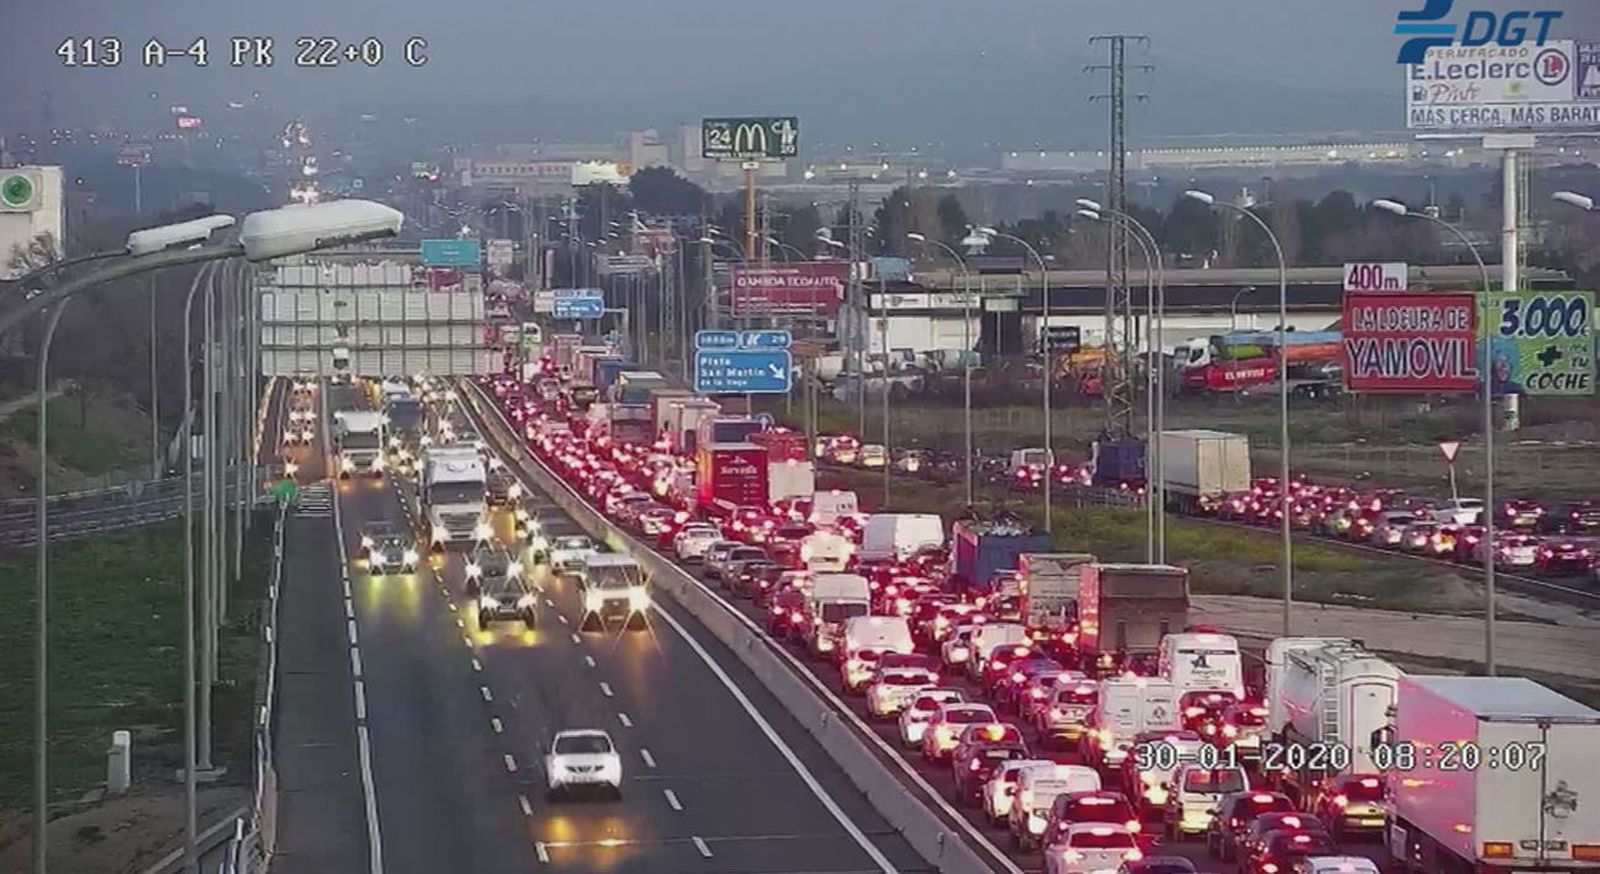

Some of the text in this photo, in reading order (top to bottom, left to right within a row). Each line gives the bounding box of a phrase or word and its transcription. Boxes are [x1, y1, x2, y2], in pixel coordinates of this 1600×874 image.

[1411, 59, 1531, 80] E.Leclerc
[710, 129, 732, 144] 24
[1348, 264, 1400, 290] 400m
[1352, 307, 1470, 332] LA LOCURA DE
[1526, 373, 1591, 391] COCHE
